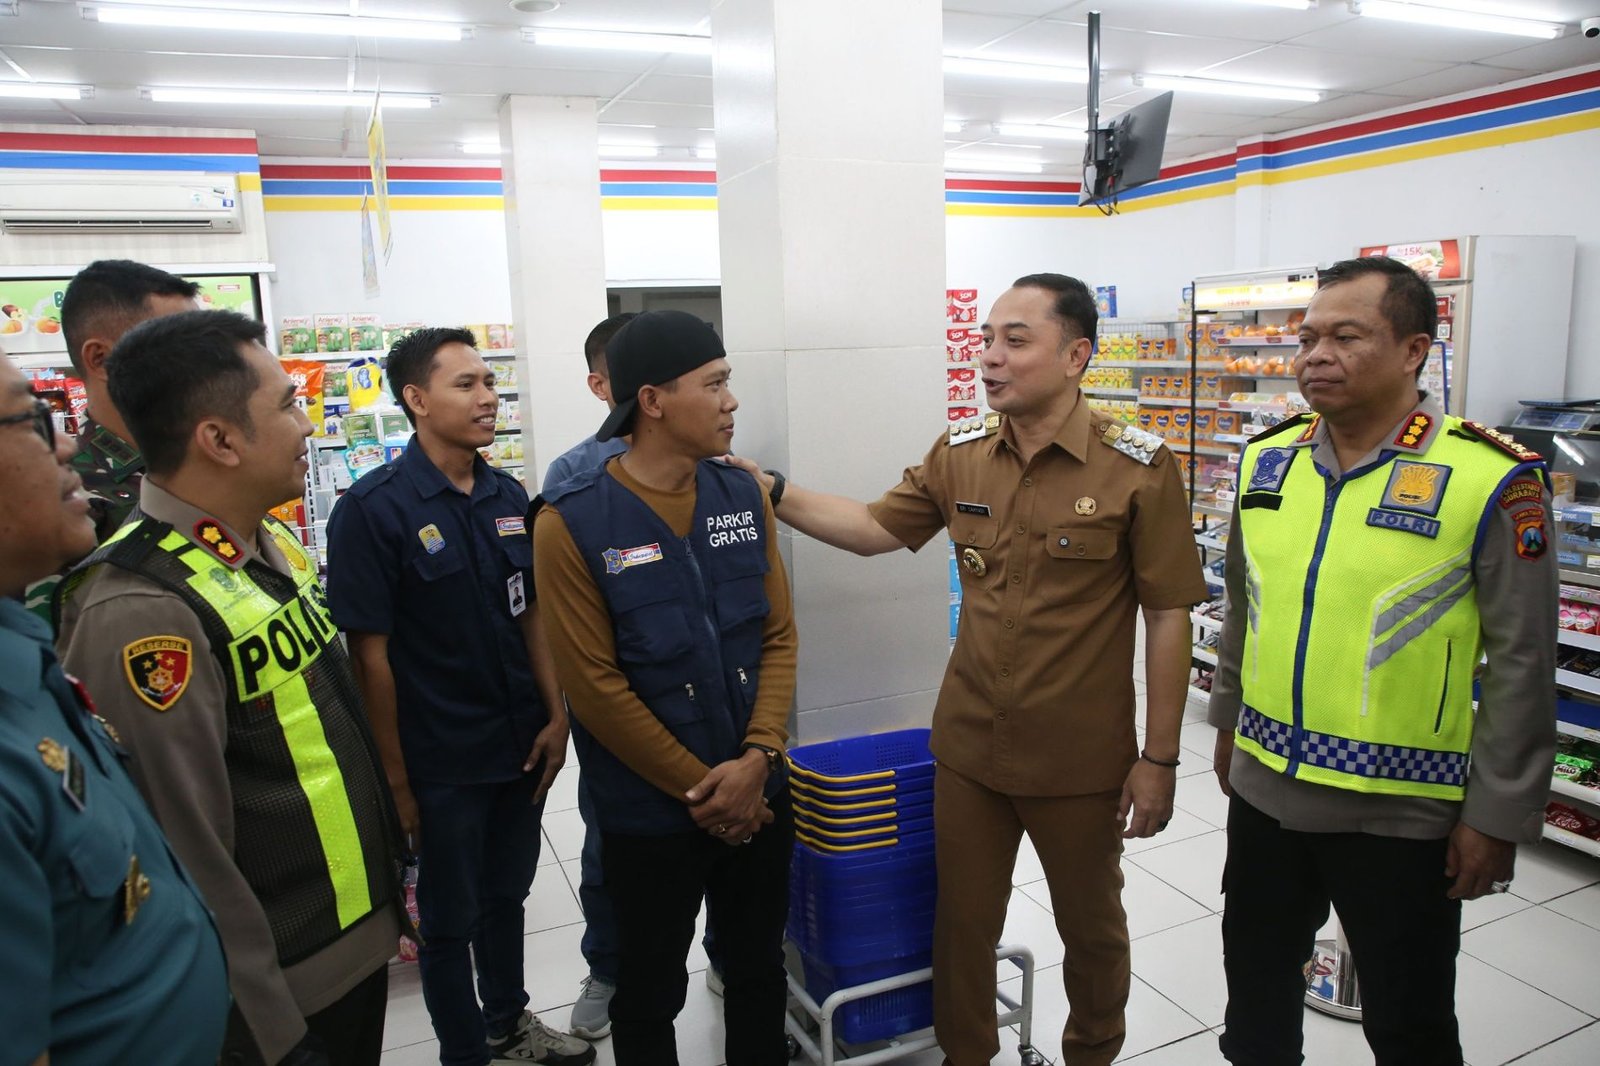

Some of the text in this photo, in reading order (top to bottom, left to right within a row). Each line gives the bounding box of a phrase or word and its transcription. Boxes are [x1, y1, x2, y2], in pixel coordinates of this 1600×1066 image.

[706, 510, 755, 532] PARKIR
[1371, 511, 1434, 533] POLRI
[709, 526, 758, 547] GRATIS
[132, 640, 184, 654] RESERSE
